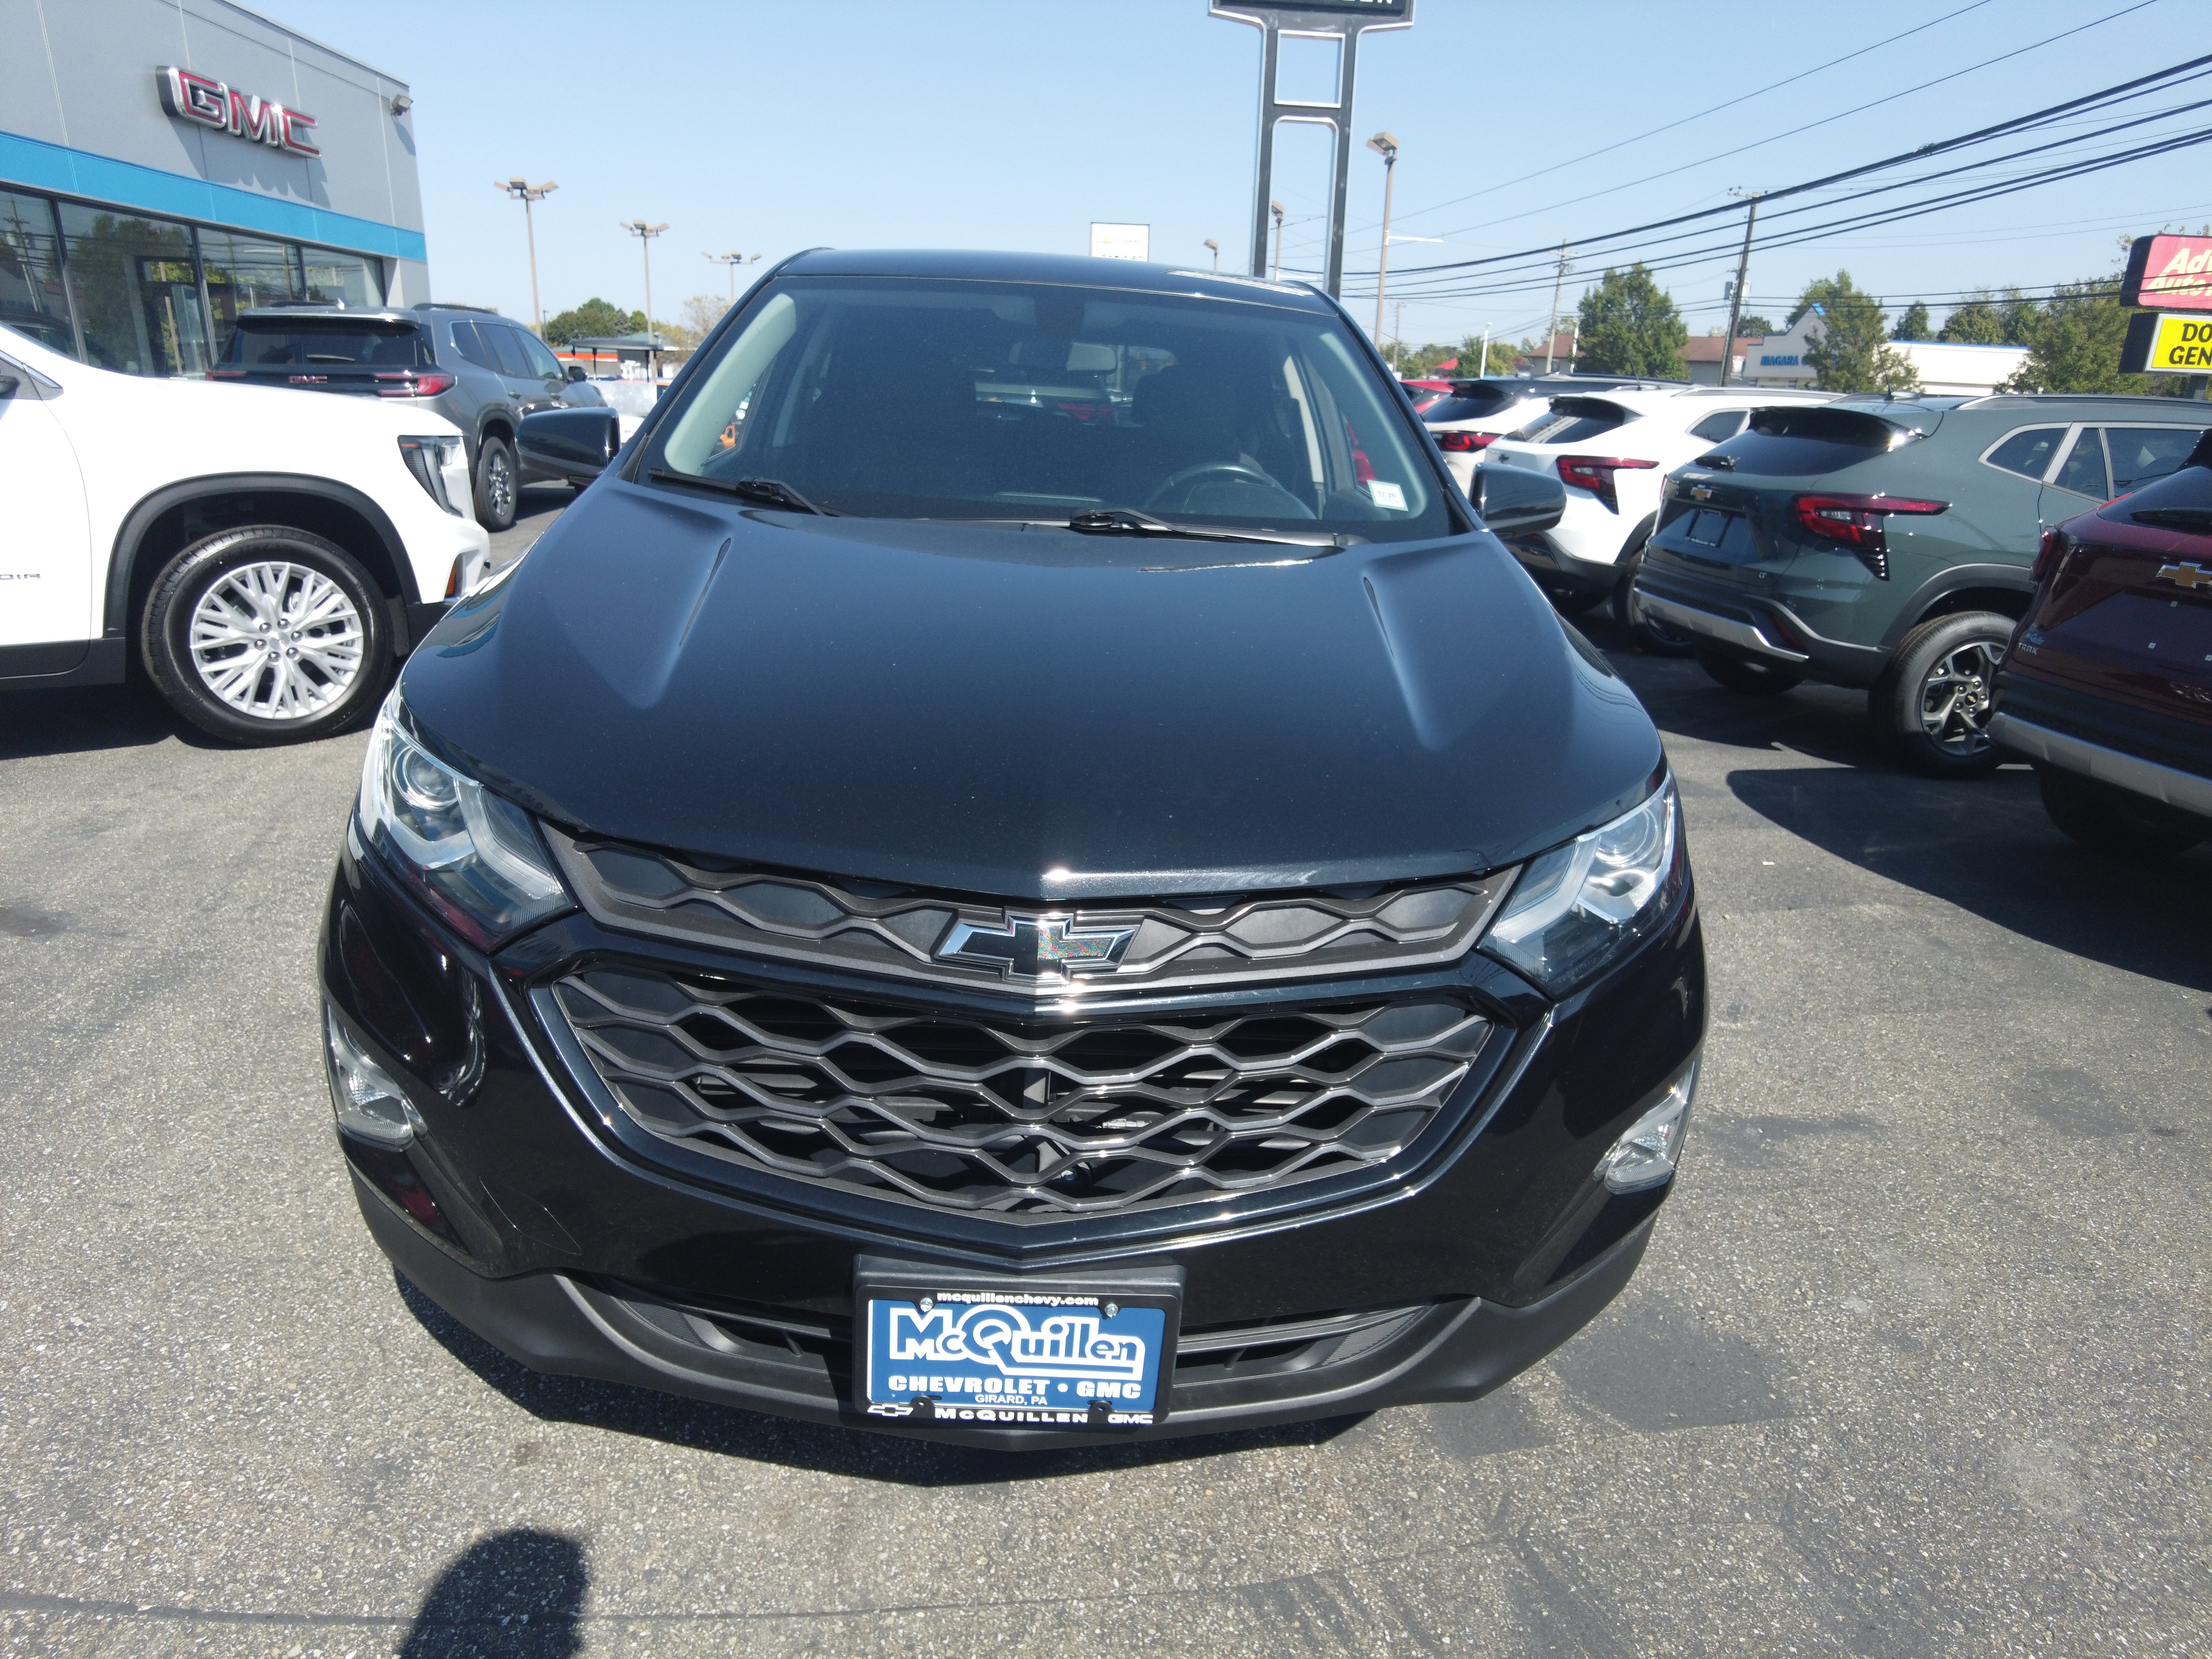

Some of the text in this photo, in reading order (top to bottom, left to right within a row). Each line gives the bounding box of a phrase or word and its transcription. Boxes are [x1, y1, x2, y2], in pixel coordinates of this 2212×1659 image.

[160, 65, 323, 159] GMC
[289, 375, 327, 384] GMC
[937, 1292, 1099, 1307] mcquillenchevy.com
[890, 1304, 1145, 1381] McQuillen
[888, 1375, 1142, 1399] CHEVROLET GMC
[974, 1394, 1048, 1406] GIRARD, PA
[1107, 1413, 1154, 1424] GMC
